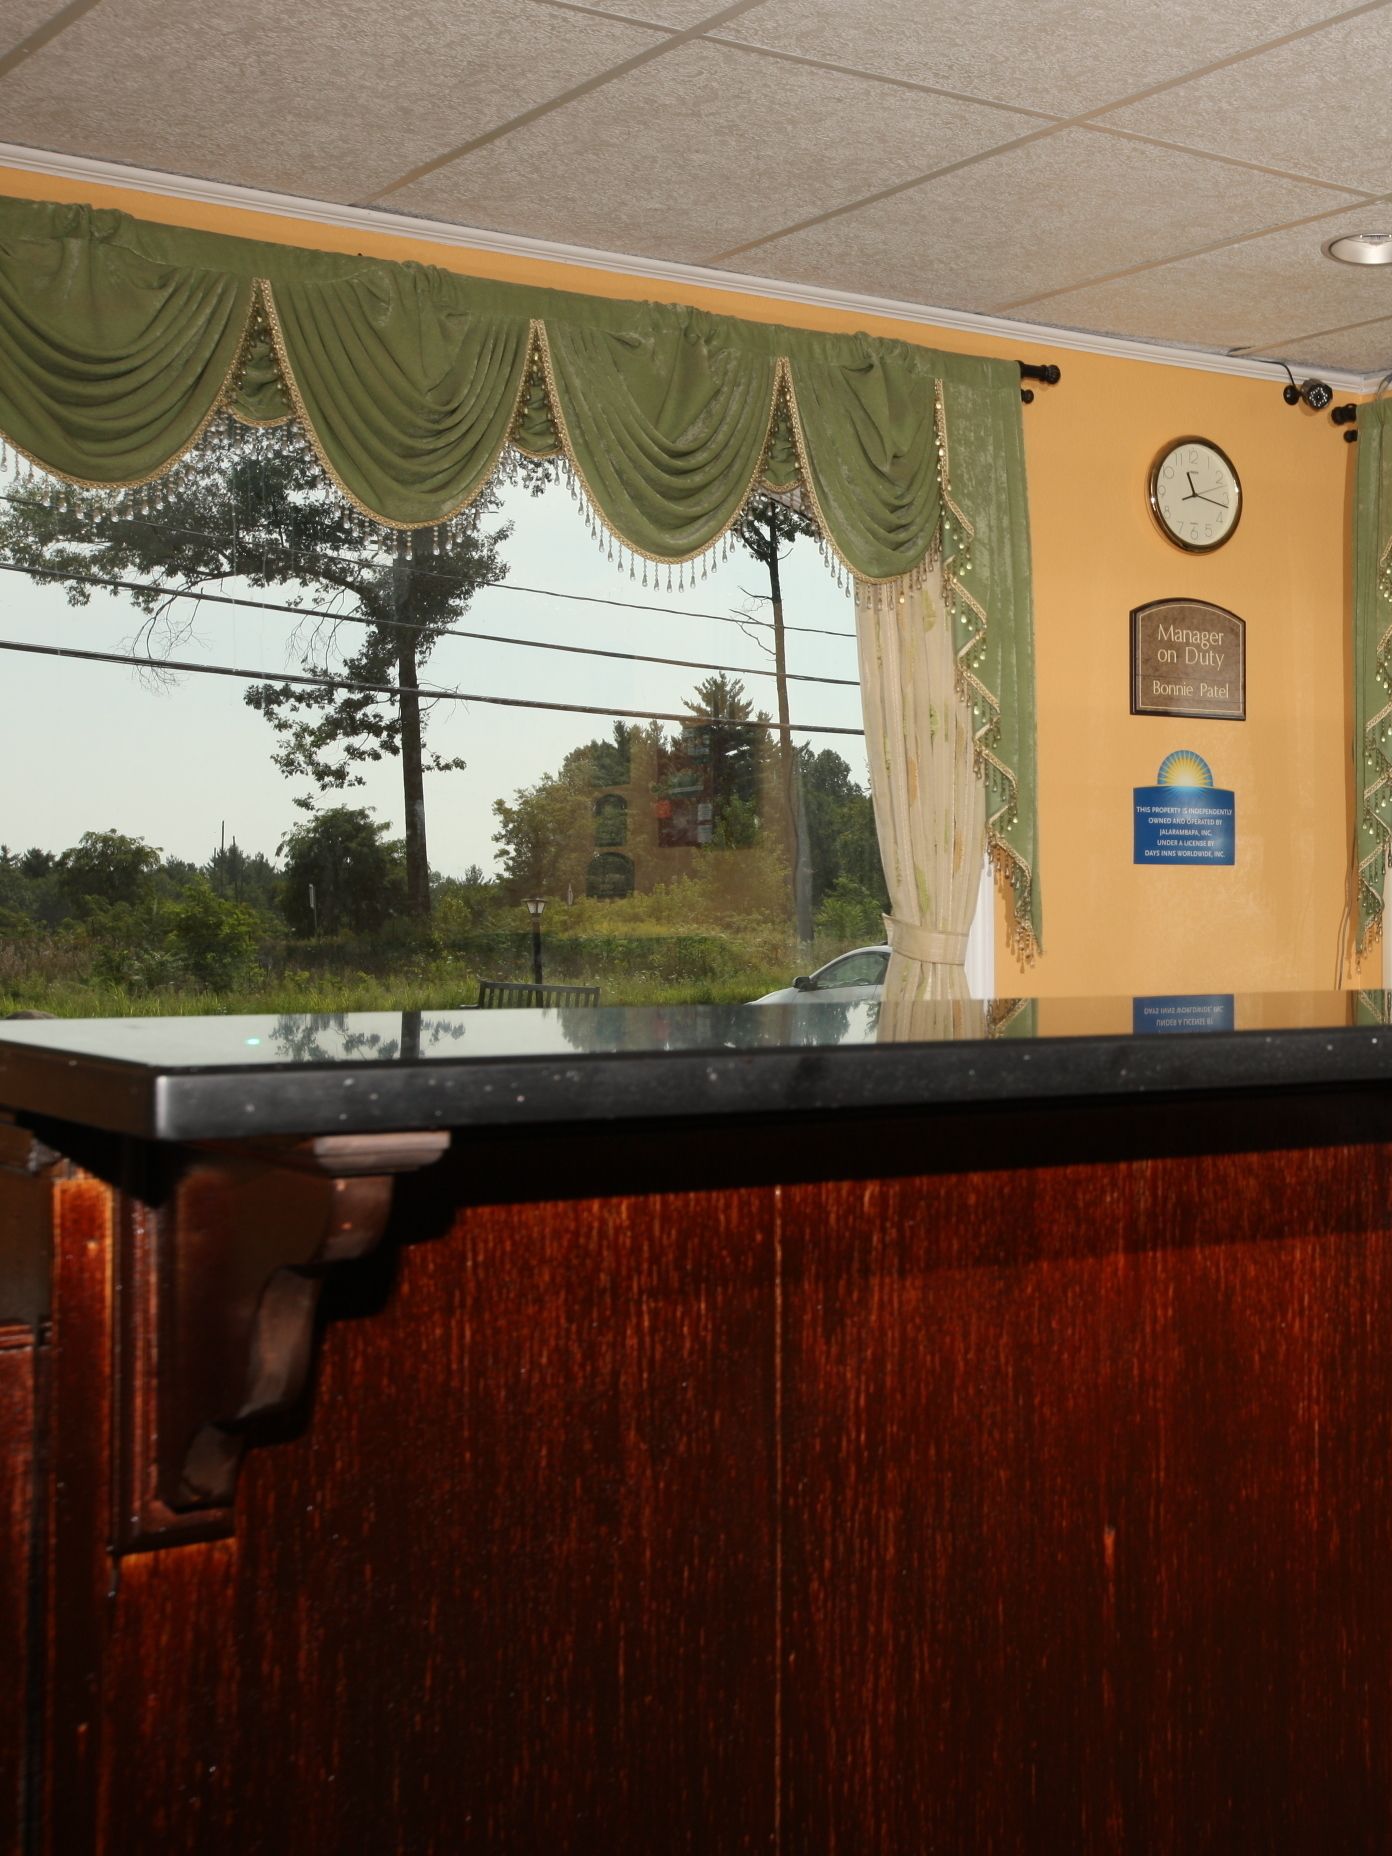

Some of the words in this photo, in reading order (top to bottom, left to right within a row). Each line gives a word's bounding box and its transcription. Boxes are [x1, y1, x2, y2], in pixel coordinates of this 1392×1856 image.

[1174, 452, 1182, 467] 11
[1189, 449, 1199, 464] 12
[1162, 466, 1174, 480] 10
[1216, 470, 1223, 484] 2
[1158, 484, 1166, 498] 9
[1222, 492, 1229, 506] 3
[1164, 506, 1171, 519] 8
[1216, 512, 1223, 524] 4
[1177, 520, 1184, 534] 7
[1190, 526, 1198, 540] 6
[1204, 524, 1212, 538] 5
[1158, 624, 1224, 650] Manager
[1158, 649, 1176, 663] on
[1185, 646, 1224, 670] Duty
[1153, 680, 1194, 696] Bonnie
[1200, 682, 1229, 699] Patel
[1188, 808, 1232, 816] INDEPENDENTLY
